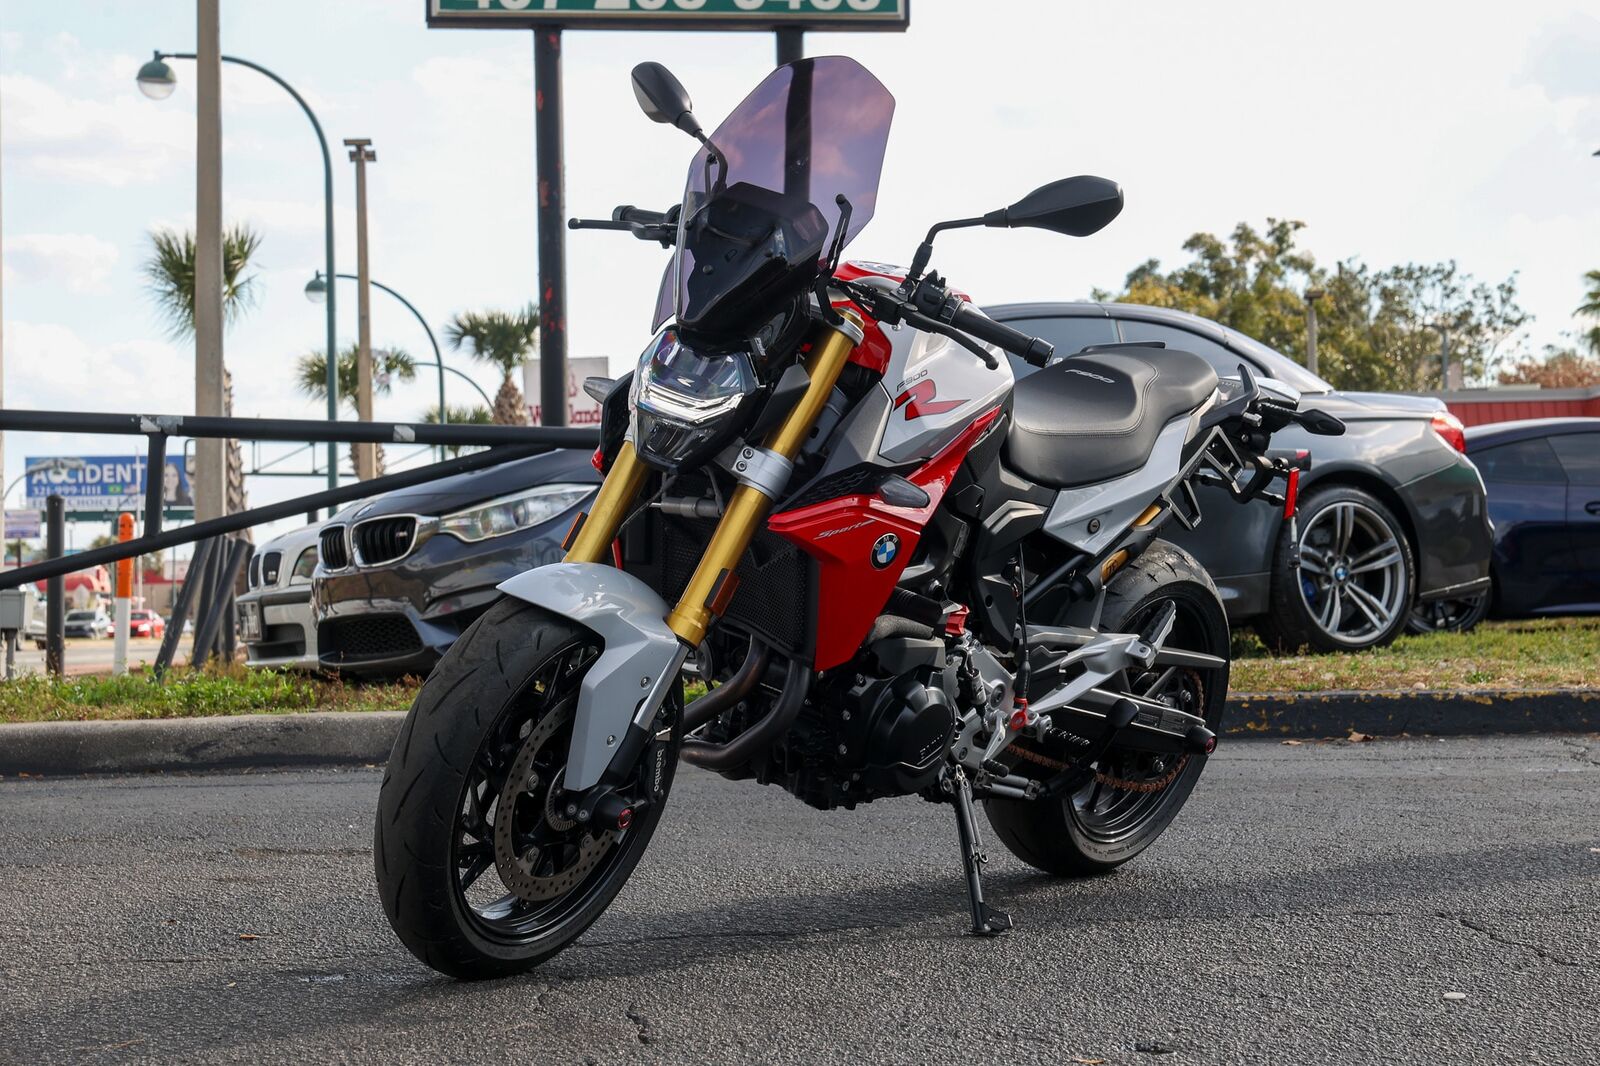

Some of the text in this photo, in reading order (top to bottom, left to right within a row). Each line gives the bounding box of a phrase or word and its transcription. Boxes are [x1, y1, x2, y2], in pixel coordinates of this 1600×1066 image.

[896, 369, 929, 392] F900
[814, 519, 876, 540] Sport
[653, 748, 665, 792] brembo
